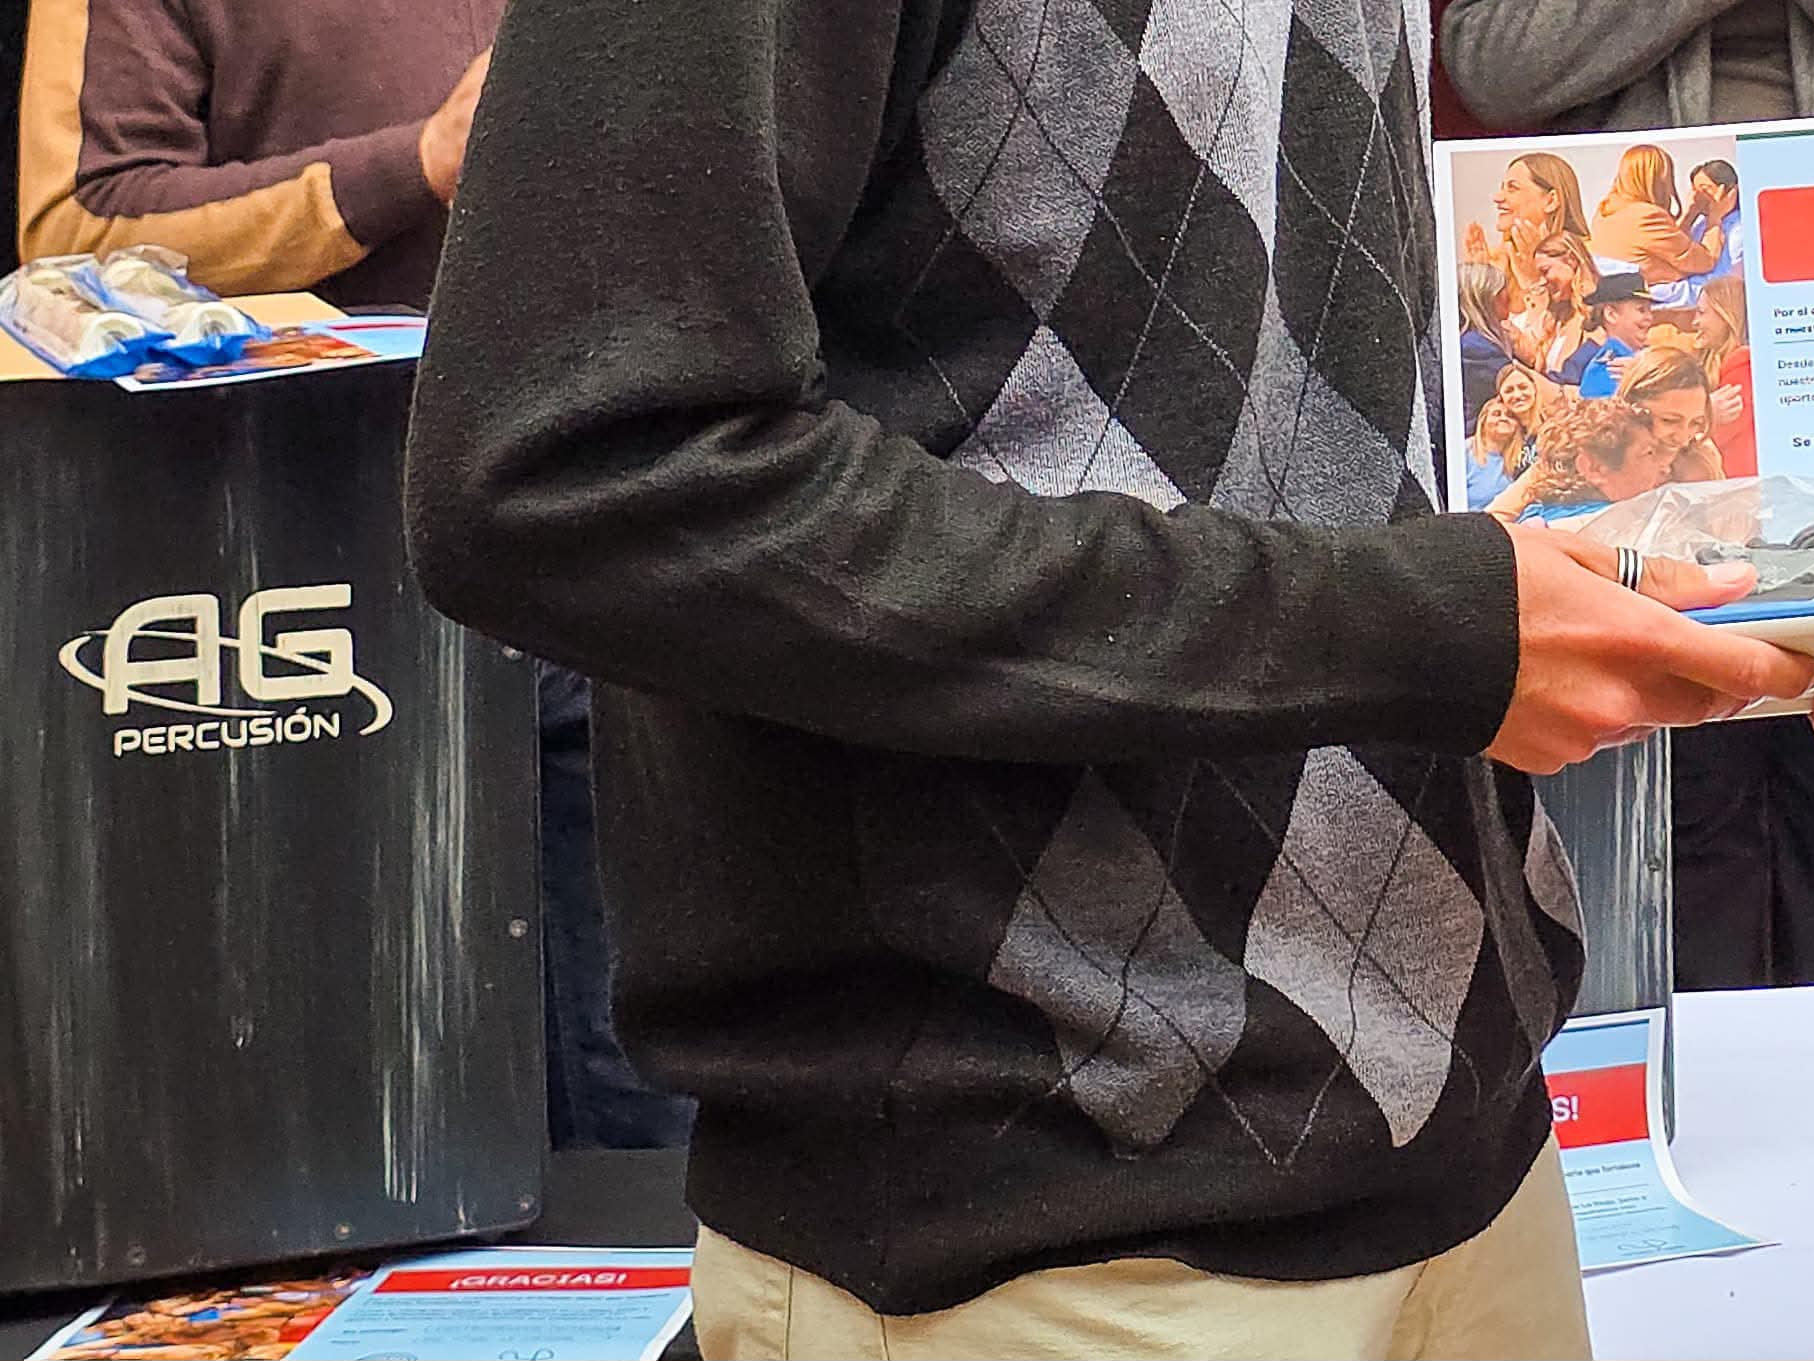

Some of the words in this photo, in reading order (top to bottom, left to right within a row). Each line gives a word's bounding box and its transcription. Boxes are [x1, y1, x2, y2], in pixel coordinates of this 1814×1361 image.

[1793, 436, 1811, 448] Se
[103, 583, 354, 715] AG
[113, 706, 340, 757] PERCUSIÓN
